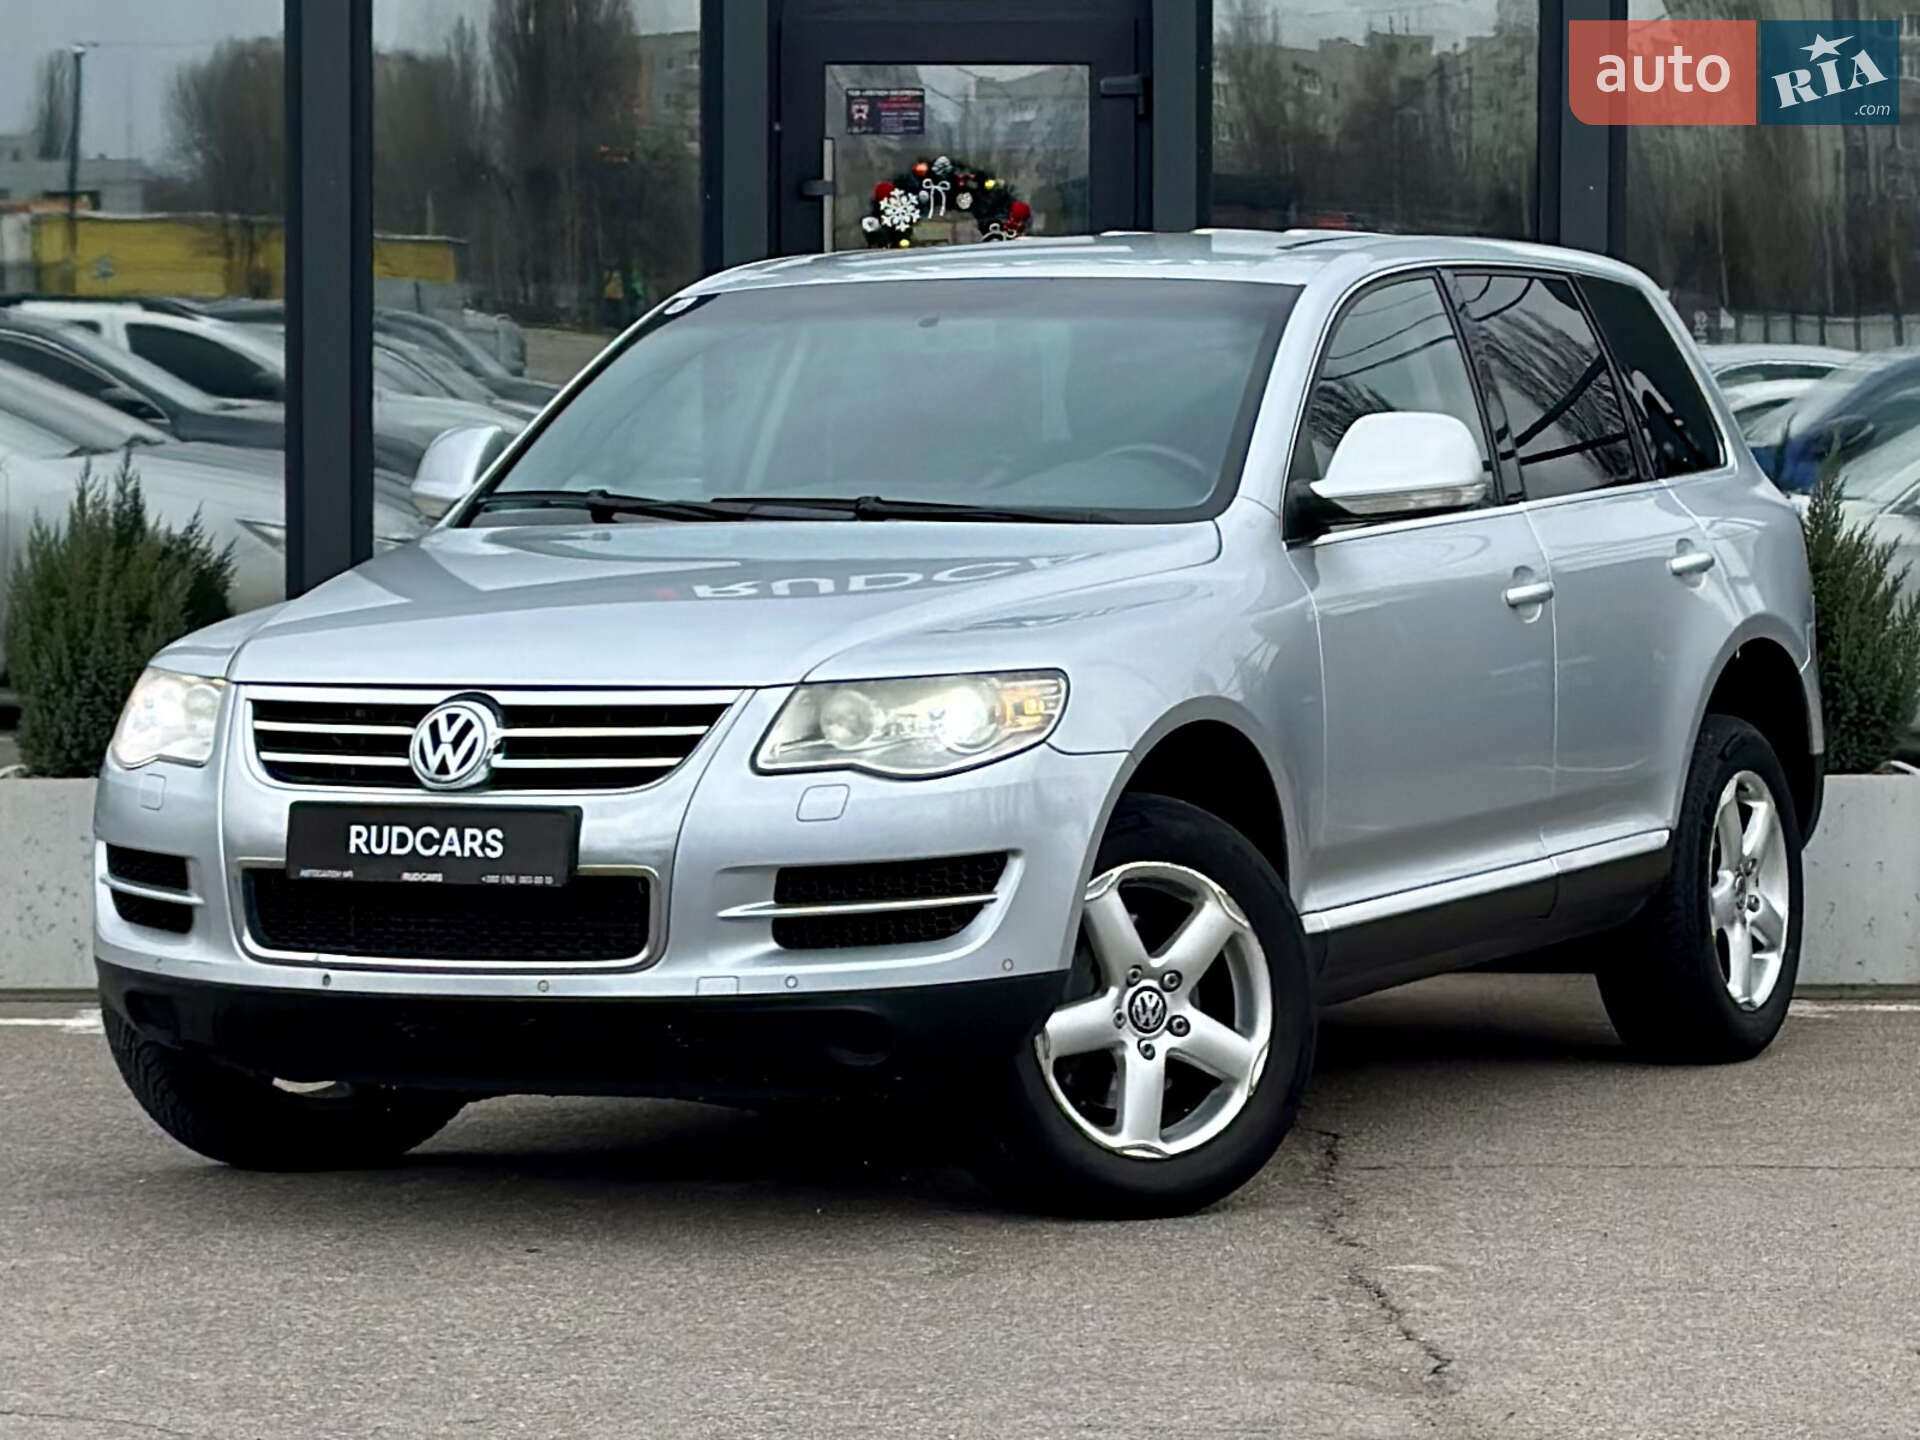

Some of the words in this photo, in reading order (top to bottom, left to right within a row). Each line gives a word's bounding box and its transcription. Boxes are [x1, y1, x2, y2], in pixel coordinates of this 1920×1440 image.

[413, 702, 490, 785] VW
[349, 825, 504, 859] RUDCARS
[1131, 988, 1165, 1031] VW
